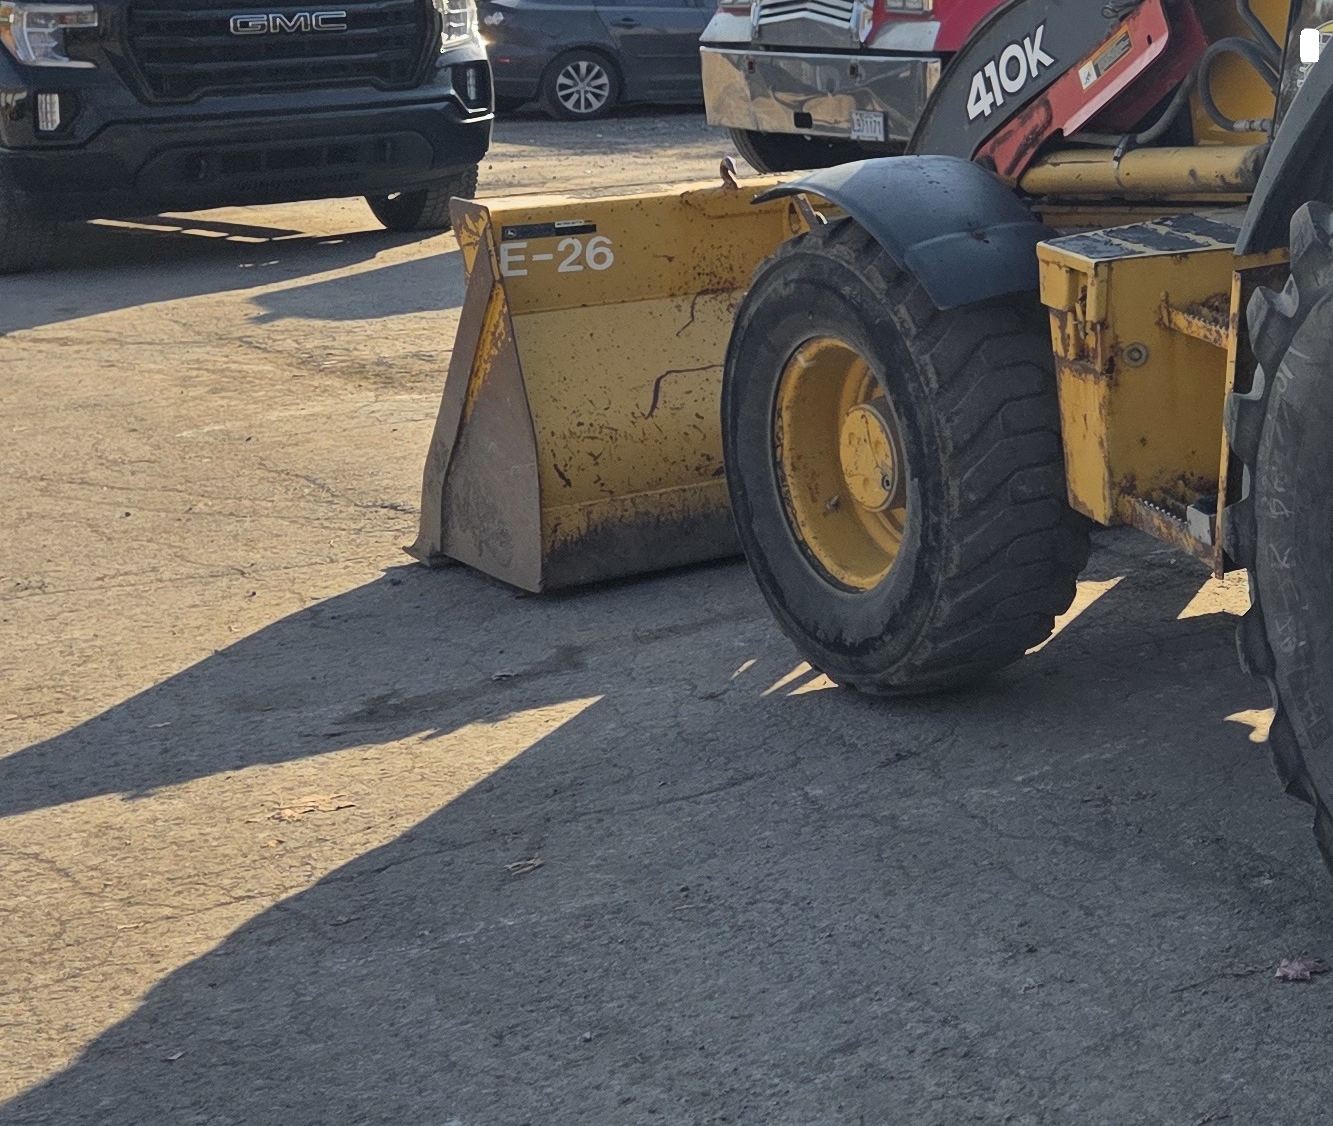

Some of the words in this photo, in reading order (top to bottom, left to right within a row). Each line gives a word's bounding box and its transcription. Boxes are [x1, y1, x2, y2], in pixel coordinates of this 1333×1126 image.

[229, 10, 347, 36] GMC
[966, 24, 1055, 121] 410K
[500, 235, 614, 278] E-26
